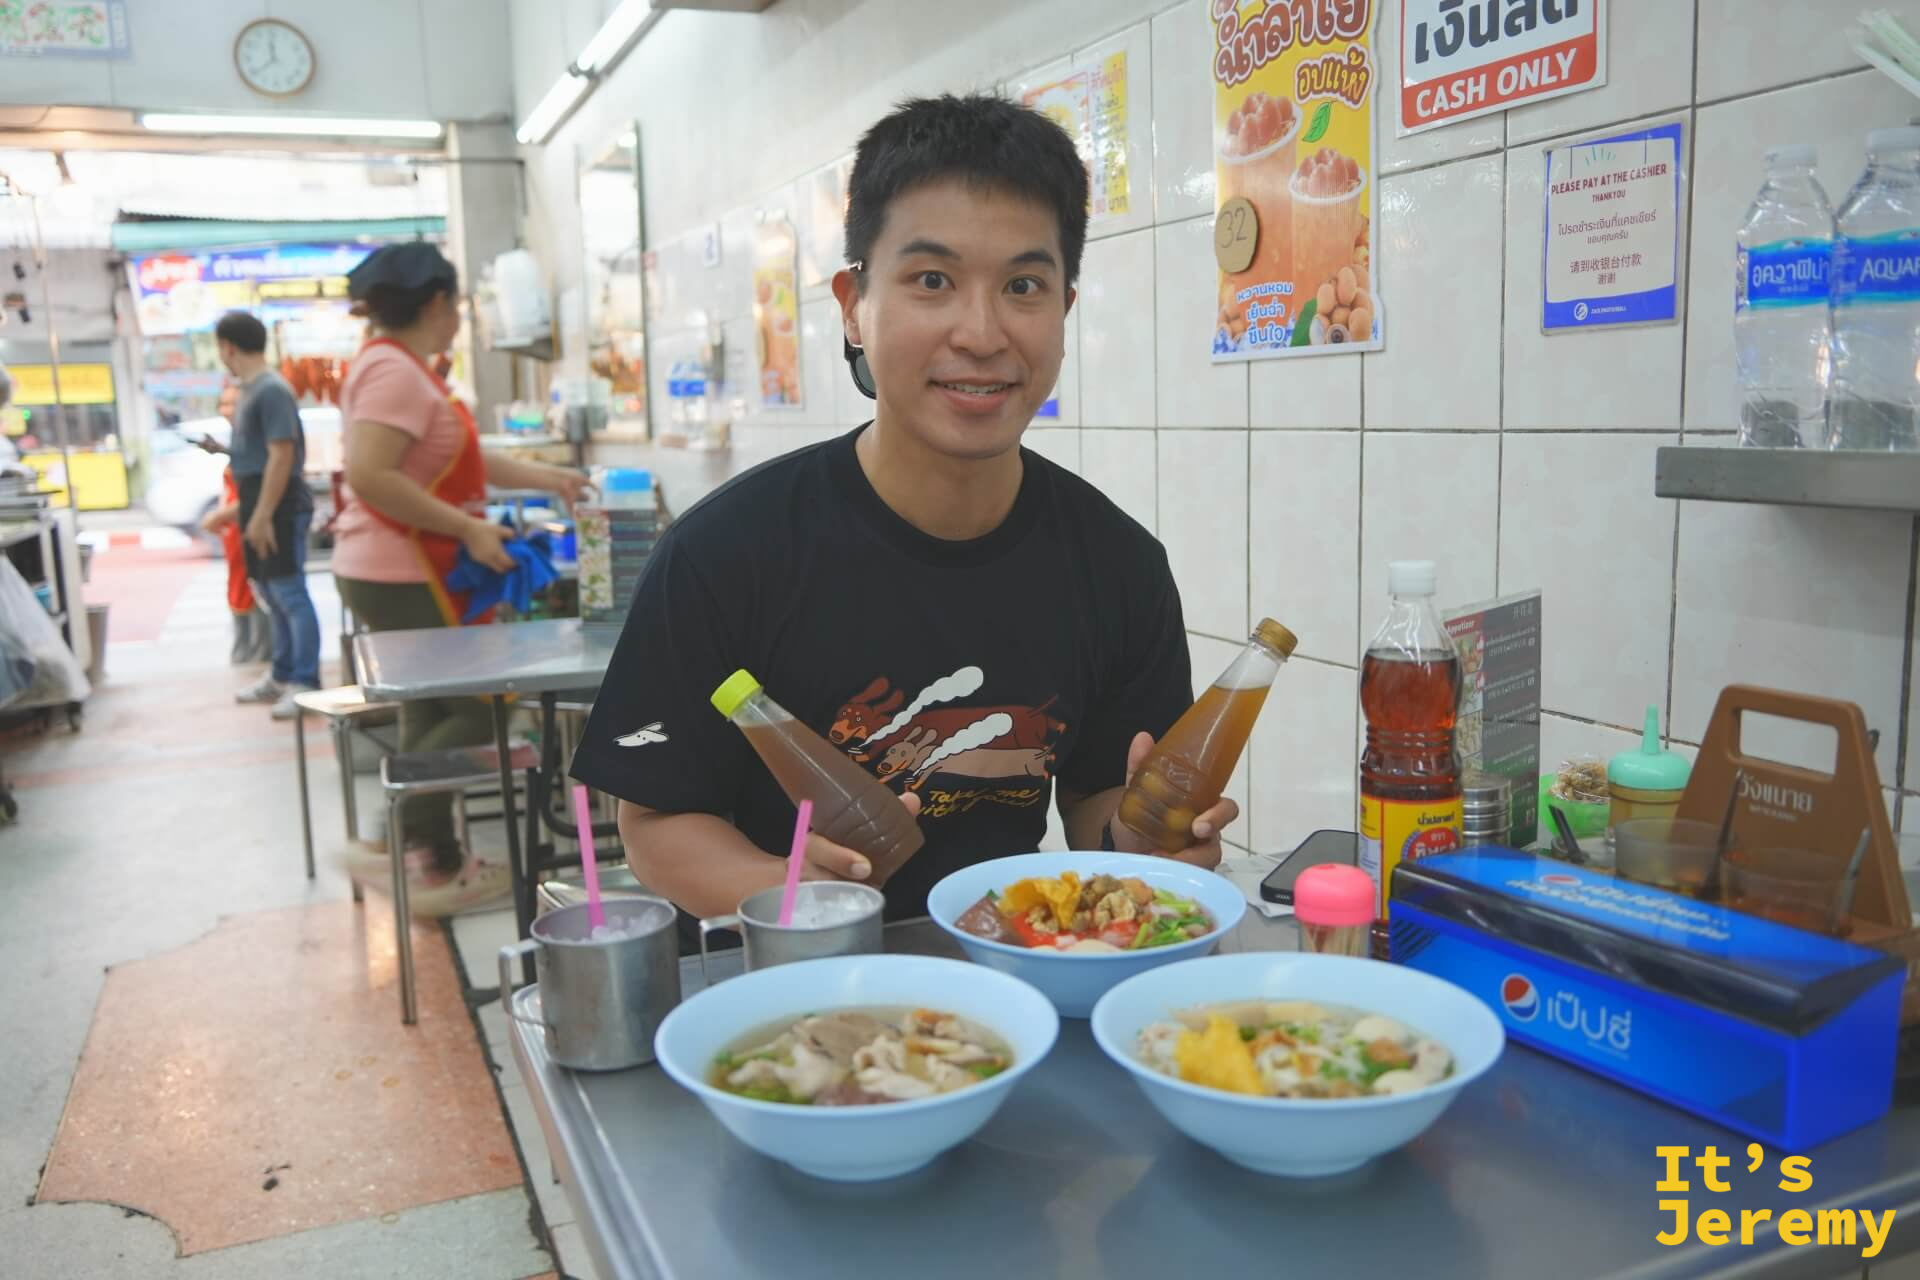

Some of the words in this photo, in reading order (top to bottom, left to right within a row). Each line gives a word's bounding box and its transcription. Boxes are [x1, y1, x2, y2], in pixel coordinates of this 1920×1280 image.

[1416, 73, 1487, 119] CASH
[1497, 47, 1577, 96] ONLY
[1551, 179, 1581, 195] PLEASE
[1582, 176, 1599, 190] PAY
[1600, 174, 1612, 187] AT
[1613, 170, 1629, 184] THE
[1630, 163, 1667, 181] CASHIER
[1220, 207, 1248, 249] 32
[1569, 253, 1642, 273] 请到收银台付款
